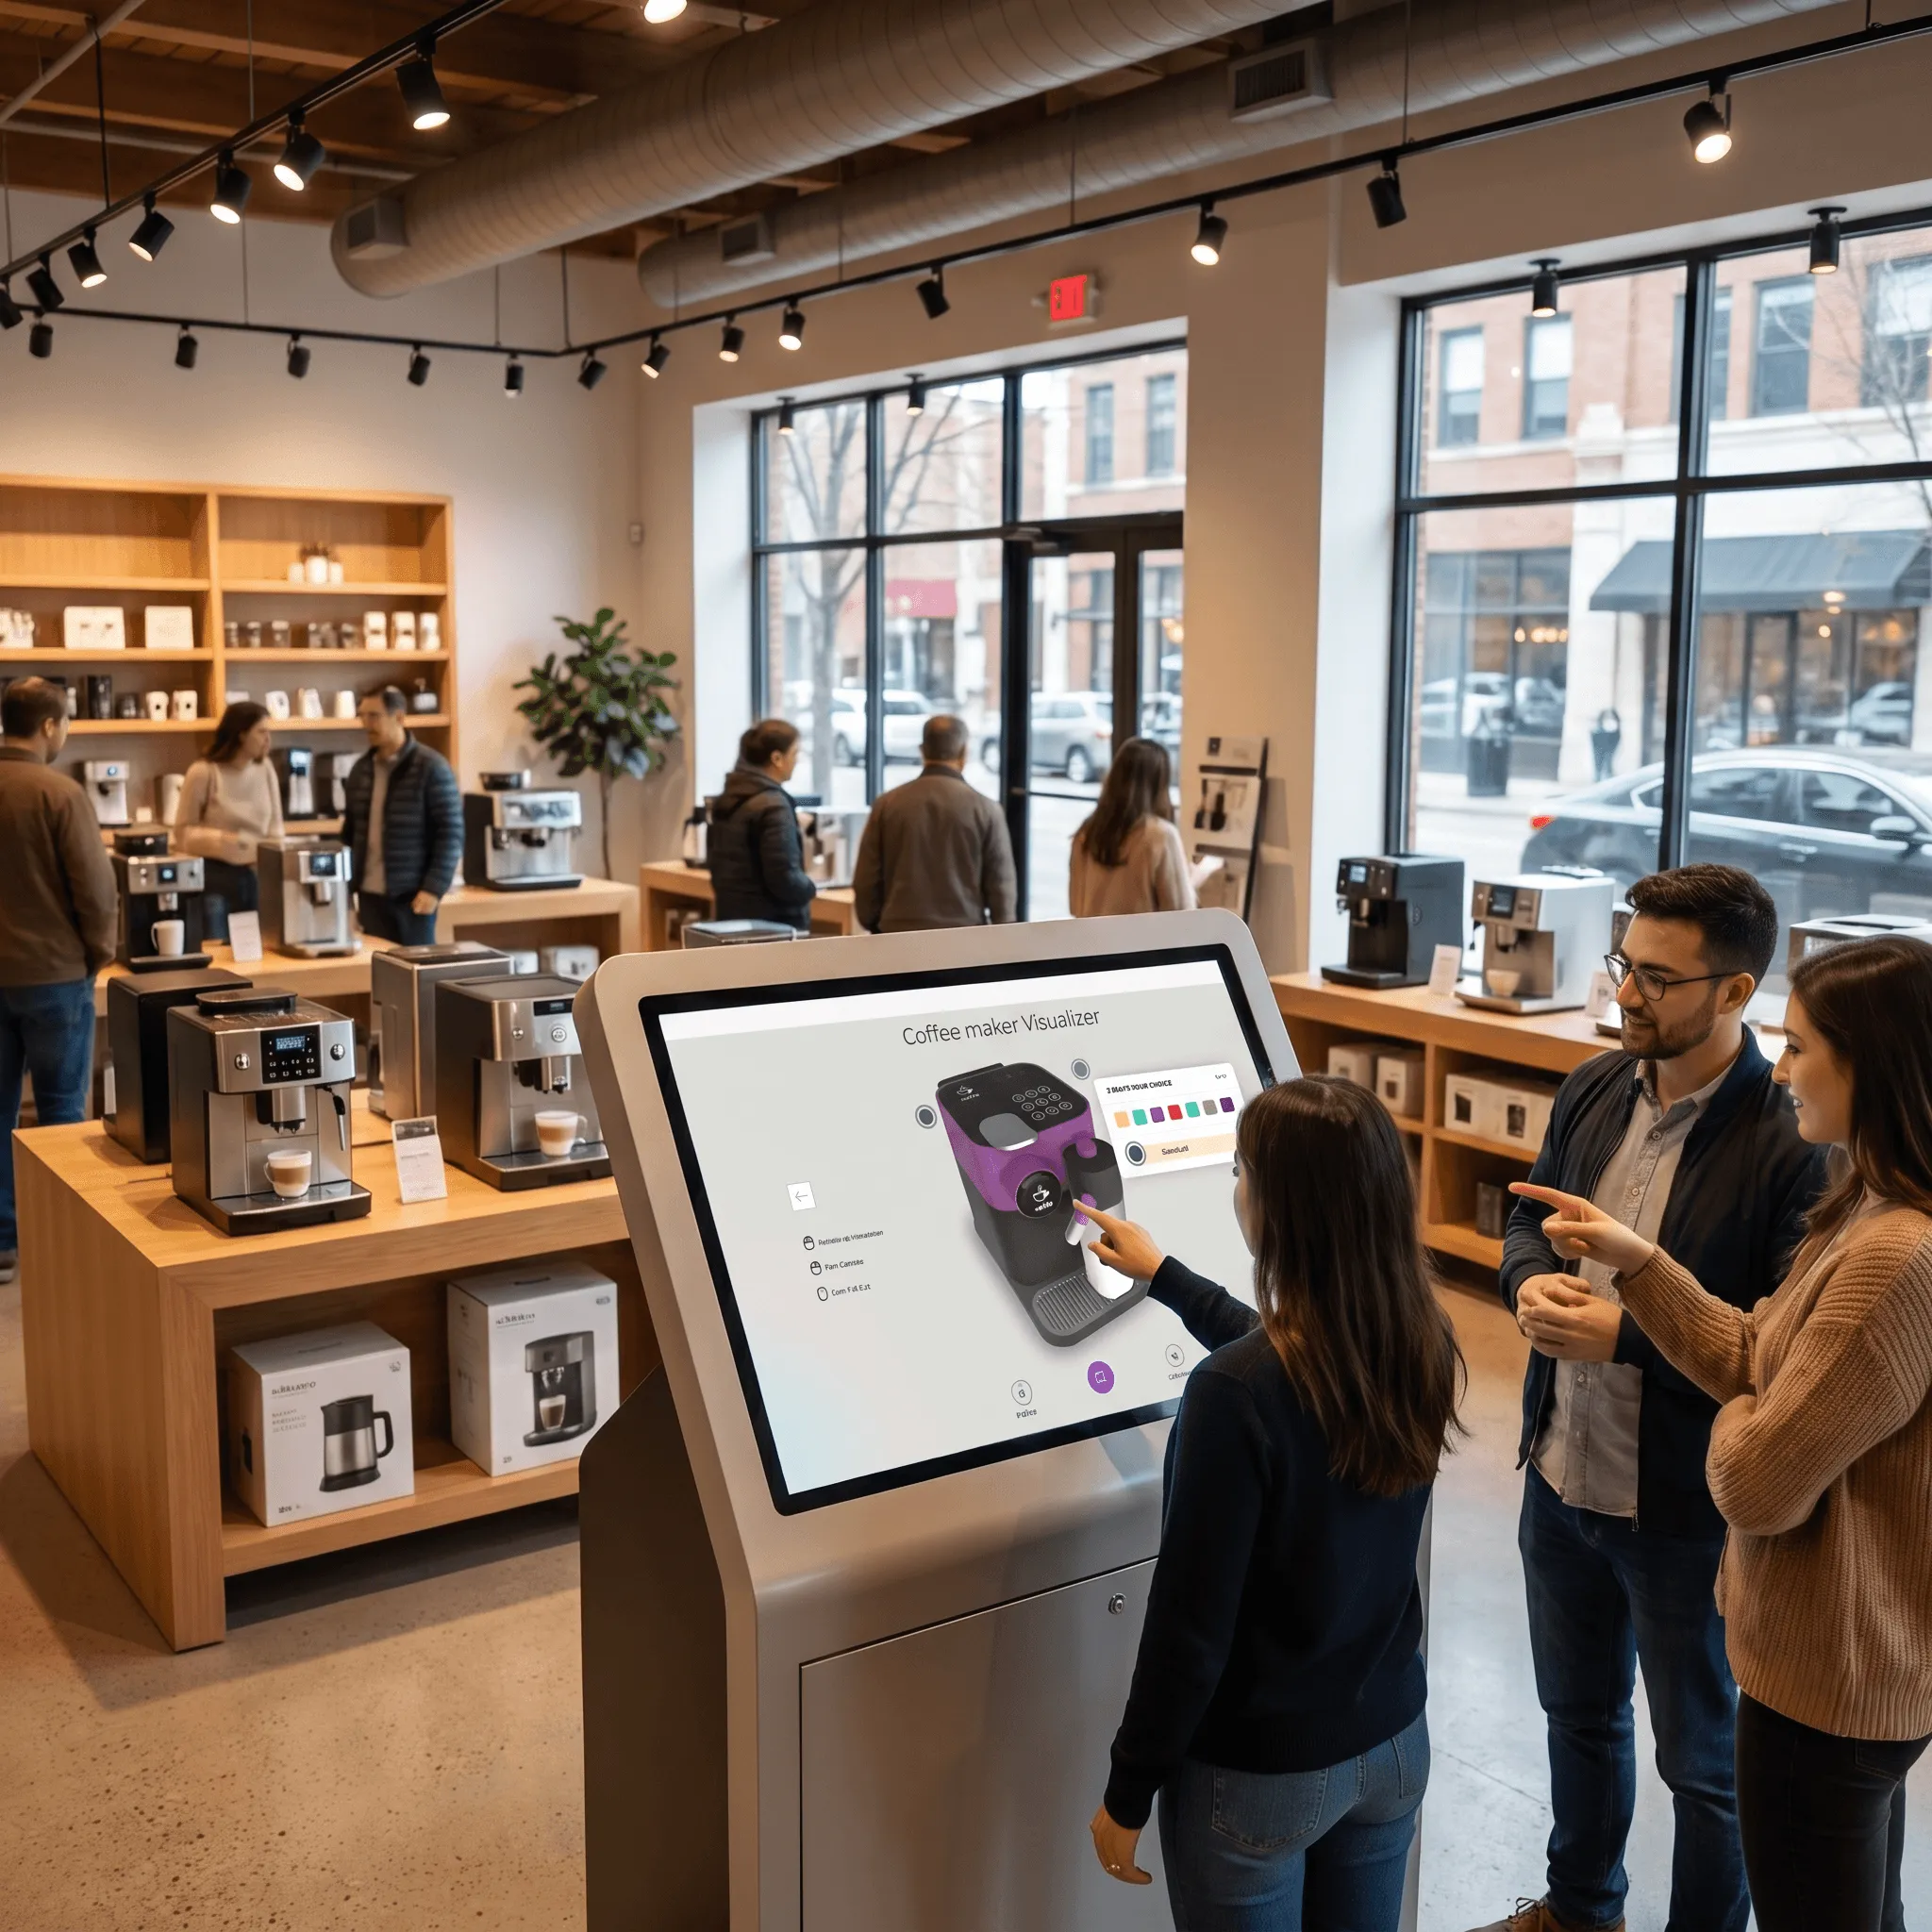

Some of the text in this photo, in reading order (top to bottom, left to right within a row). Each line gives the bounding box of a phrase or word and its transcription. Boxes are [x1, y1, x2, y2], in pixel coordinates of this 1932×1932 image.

[903, 1009, 1100, 1045] Coffee maker Visualizer
